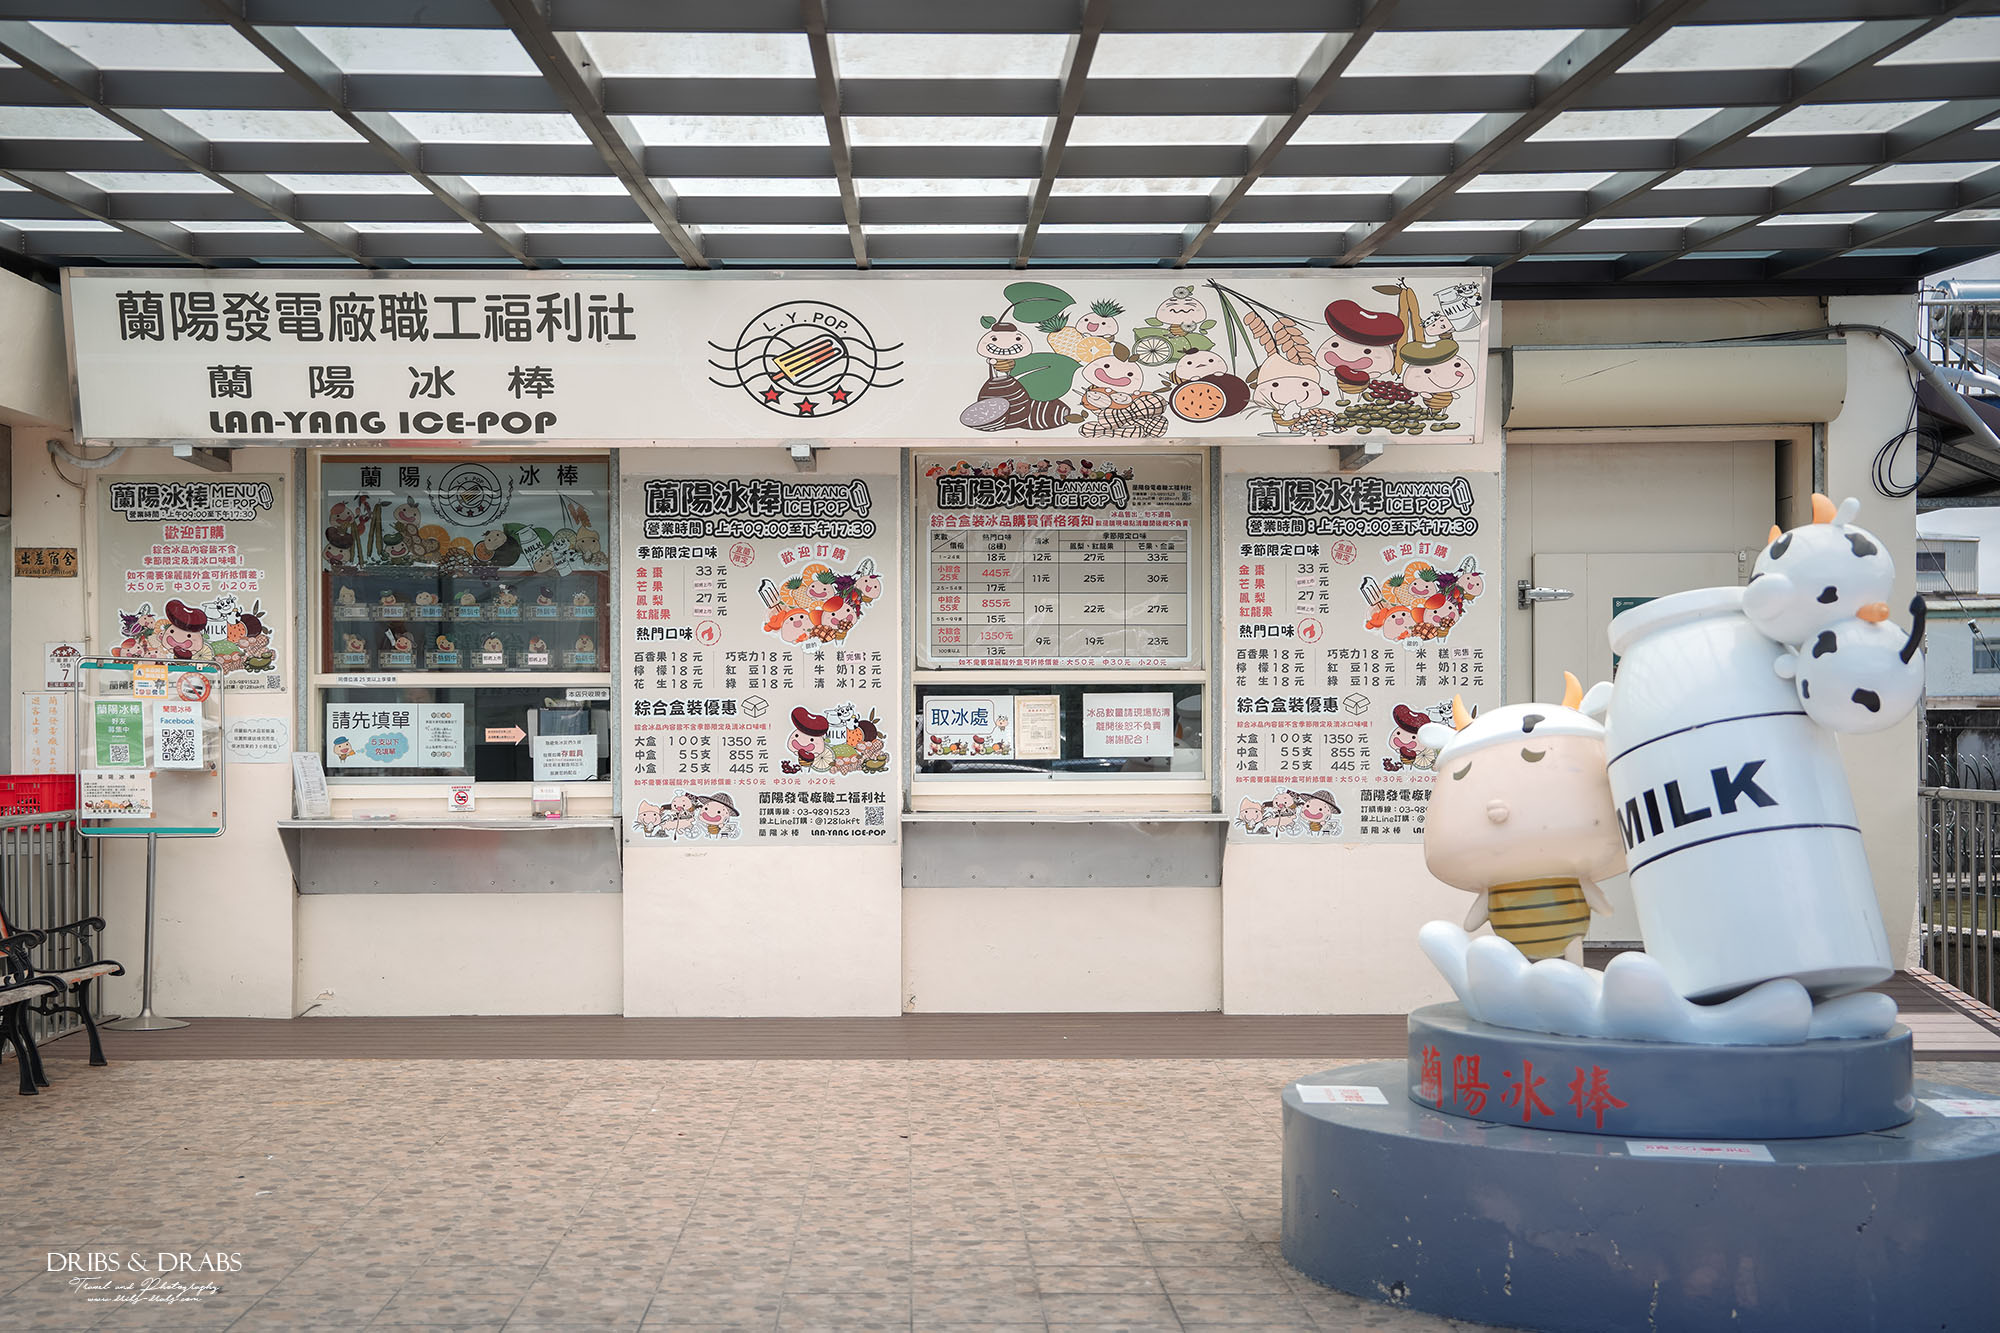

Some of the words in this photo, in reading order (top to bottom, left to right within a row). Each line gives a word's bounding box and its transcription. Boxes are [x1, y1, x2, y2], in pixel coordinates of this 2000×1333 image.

[116, 291, 636, 343] 蘭陽發電廠職工福利社
[209, 411, 386, 434] LAN-YANG
[400, 411, 558, 434] ICE-POP
[112, 485, 209, 509] 蘭陽冰棒
[212, 486, 257, 498] MENU
[646, 481, 780, 516] 蘭陽冰棒
[785, 486, 848, 499] LANYANG
[938, 478, 1052, 508] 蘭陽冰棒
[1054, 482, 1108, 492] LANYANG
[1249, 479, 1383, 513] 蘭陽冰棒
[1386, 483, 1450, 496] LANYANG
[233, 500, 256, 508] POP
[1055, 495, 1078, 506] ICE
[1080, 495, 1108, 507] POP
[785, 502, 810, 516] ICE
[814, 502, 849, 516] POP
[931, 514, 1094, 528] 綜合盒裝冰品購買價格須知
[165, 526, 225, 540] 歡迎訂購
[638, 546, 718, 559] 季節限定口味
[780, 544, 847, 565] 歡迎訂購
[1240, 544, 1320, 557] 季節限定口味
[21, 551, 76, 566] 出差宿舍
[987, 553, 1006, 562] 18元
[1032, 553, 1051, 562] 12元
[1084, 553, 1105, 562] 27元
[1147, 553, 1168, 562] 33元
[938, 565, 960, 573] 小綜合
[982, 568, 1010, 577] 445元
[940, 573, 959, 581] 25支
[1032, 574, 1050, 583] 11元
[1084, 574, 1105, 583] 25元
[1147, 574, 1168, 583] 30元
[128, 582, 164, 591] 大50元
[174, 582, 210, 591] 中30元
[220, 582, 257, 591] 小20元
[987, 584, 1006, 592] 17元
[938, 596, 960, 604] 中綜合
[982, 599, 1010, 608] 855元
[940, 604, 959, 612] 55支
[1034, 605, 1053, 613] 10元
[1084, 605, 1105, 613] 22元
[1147, 605, 1168, 613] 27元
[636, 609, 671, 620] 紅龍果
[987, 615, 1006, 623] 15元
[204, 624, 226, 635] MILK
[636, 627, 693, 641] 熱門口味
[938, 627, 960, 635] 大綜合
[1239, 625, 1295, 639] 熱門口味
[938, 635, 960, 643] 100支
[1036, 637, 1051, 646] 9元
[1085, 637, 1105, 646] 19元
[1147, 637, 1168, 646] 23元
[980, 632, 1013, 640] 1350元
[987, 647, 1006, 655] 13元
[62, 669, 69, 680] 7
[97, 704, 140, 714] 蘭陽冰棒
[634, 700, 737, 716] 綜合盒裝優惠
[1237, 697, 1339, 714] 綜合盒裝優惠
[931, 708, 988, 726] 取冰處
[1086, 708, 1170, 718] 冰品數量請現場點清
[332, 711, 410, 729] 請先填單
[826, 730, 846, 740] MILK
[634, 736, 657, 747] 大盒
[634, 750, 657, 760] 中盒
[634, 763, 657, 774] 小盒
[759, 792, 886, 804] 蘭陽發電廠職工福利社
[1617, 759, 1779, 855] MILK
[1417, 1044, 1629, 1129] 蘭陽冰棒
